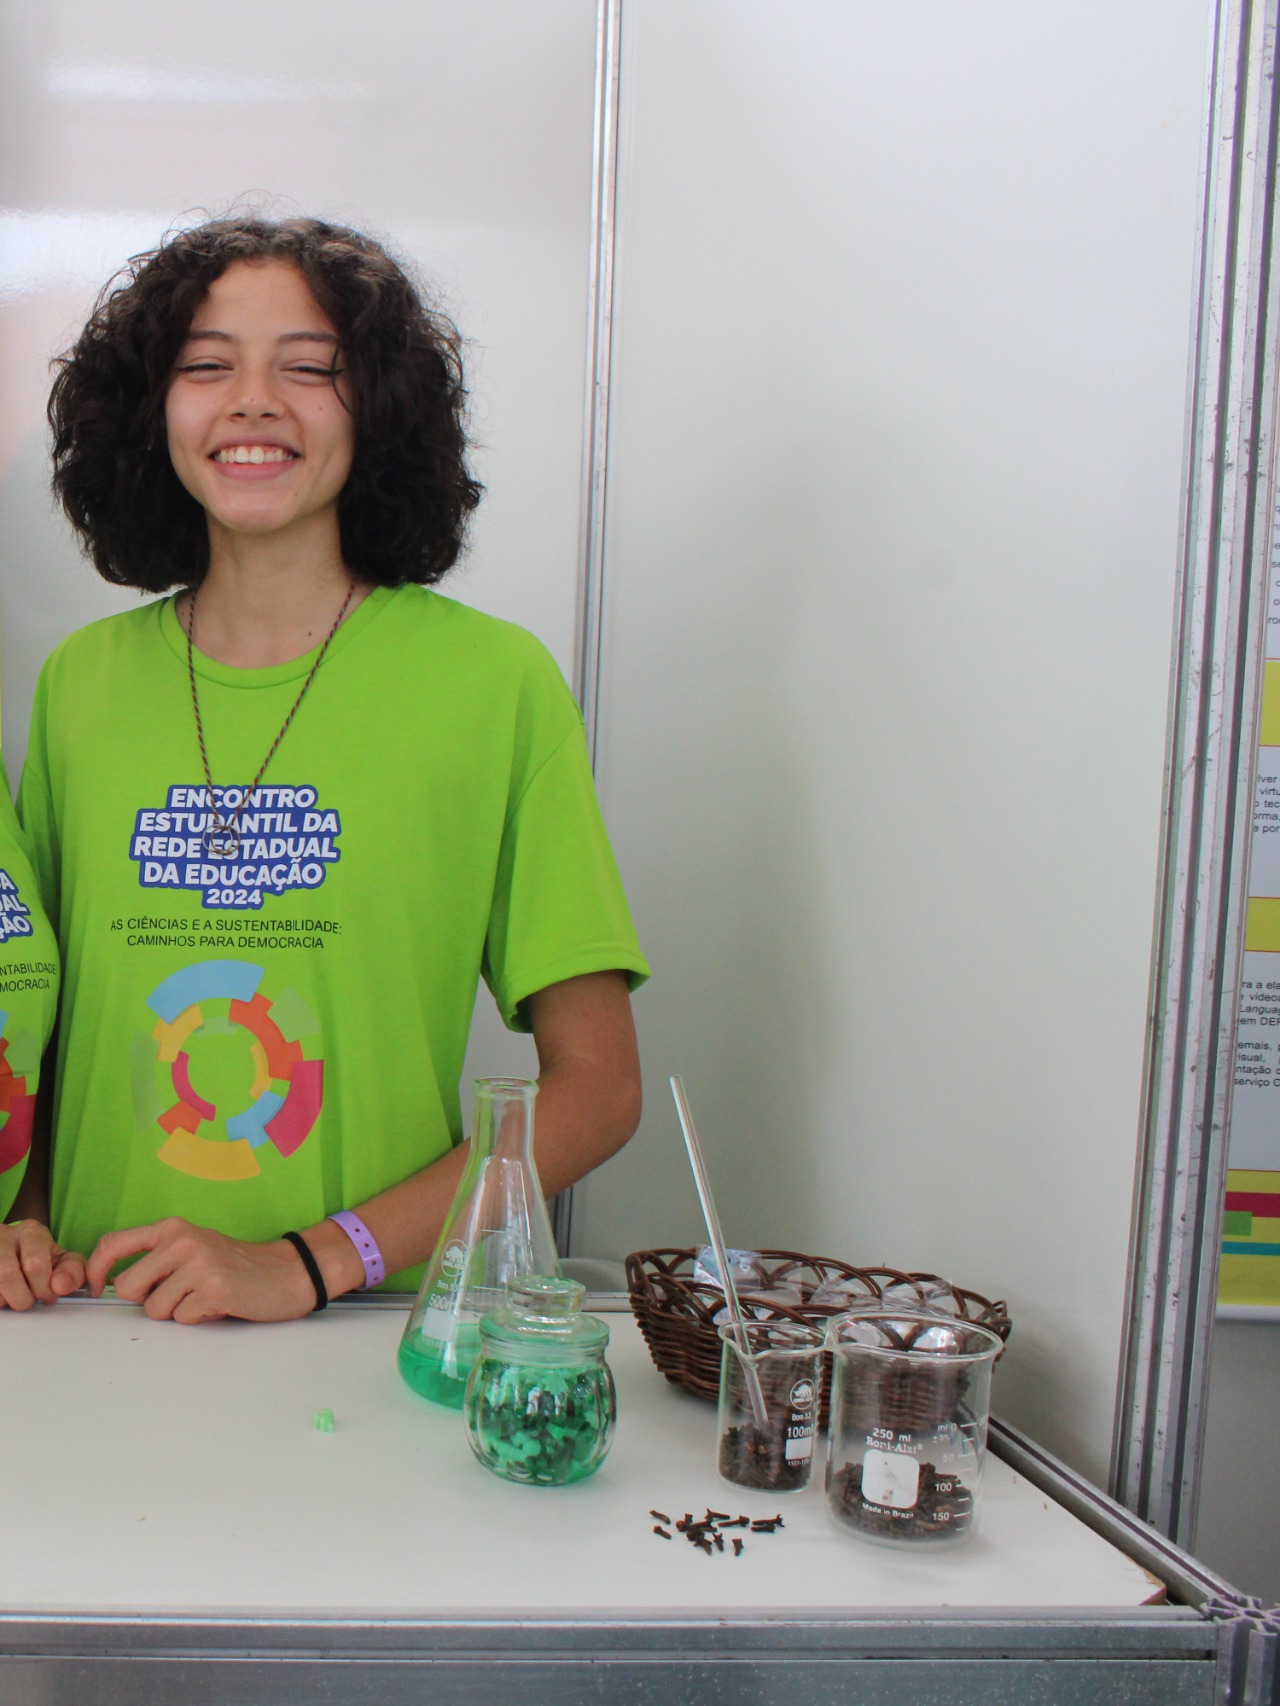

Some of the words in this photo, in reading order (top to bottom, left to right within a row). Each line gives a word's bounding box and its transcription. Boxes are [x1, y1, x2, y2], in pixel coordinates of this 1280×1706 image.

[171, 789, 315, 808] ENCONTRO
[140, 812, 297, 833] ESTUDANTIL
[303, 813, 338, 833] DA
[134, 837, 201, 858] REDE
[208, 837, 337, 859] ESTADUAL
[144, 862, 179, 883] DA
[185, 858, 322, 890] EDUCAÇÃO
[207, 889, 261, 904] 2024
[111, 919, 122, 930] AS
[127, 916, 187, 929] CIÊNCIAS
[192, 919, 199, 929] E
[204, 920, 212, 930] A
[216, 920, 342, 934] SUSTENTABILIDADE:
[127, 935, 195, 946] CAMINHOS
[200, 936, 234, 947] PARA
[239, 937, 323, 948] DEMOCRACIA
[873, 1428, 893, 1440] 250
[899, 1433, 911, 1442] ml
[935, 1483, 952, 1491] 100
[863, 1503, 880, 1513] Made
[933, 1512, 949, 1521] 150
